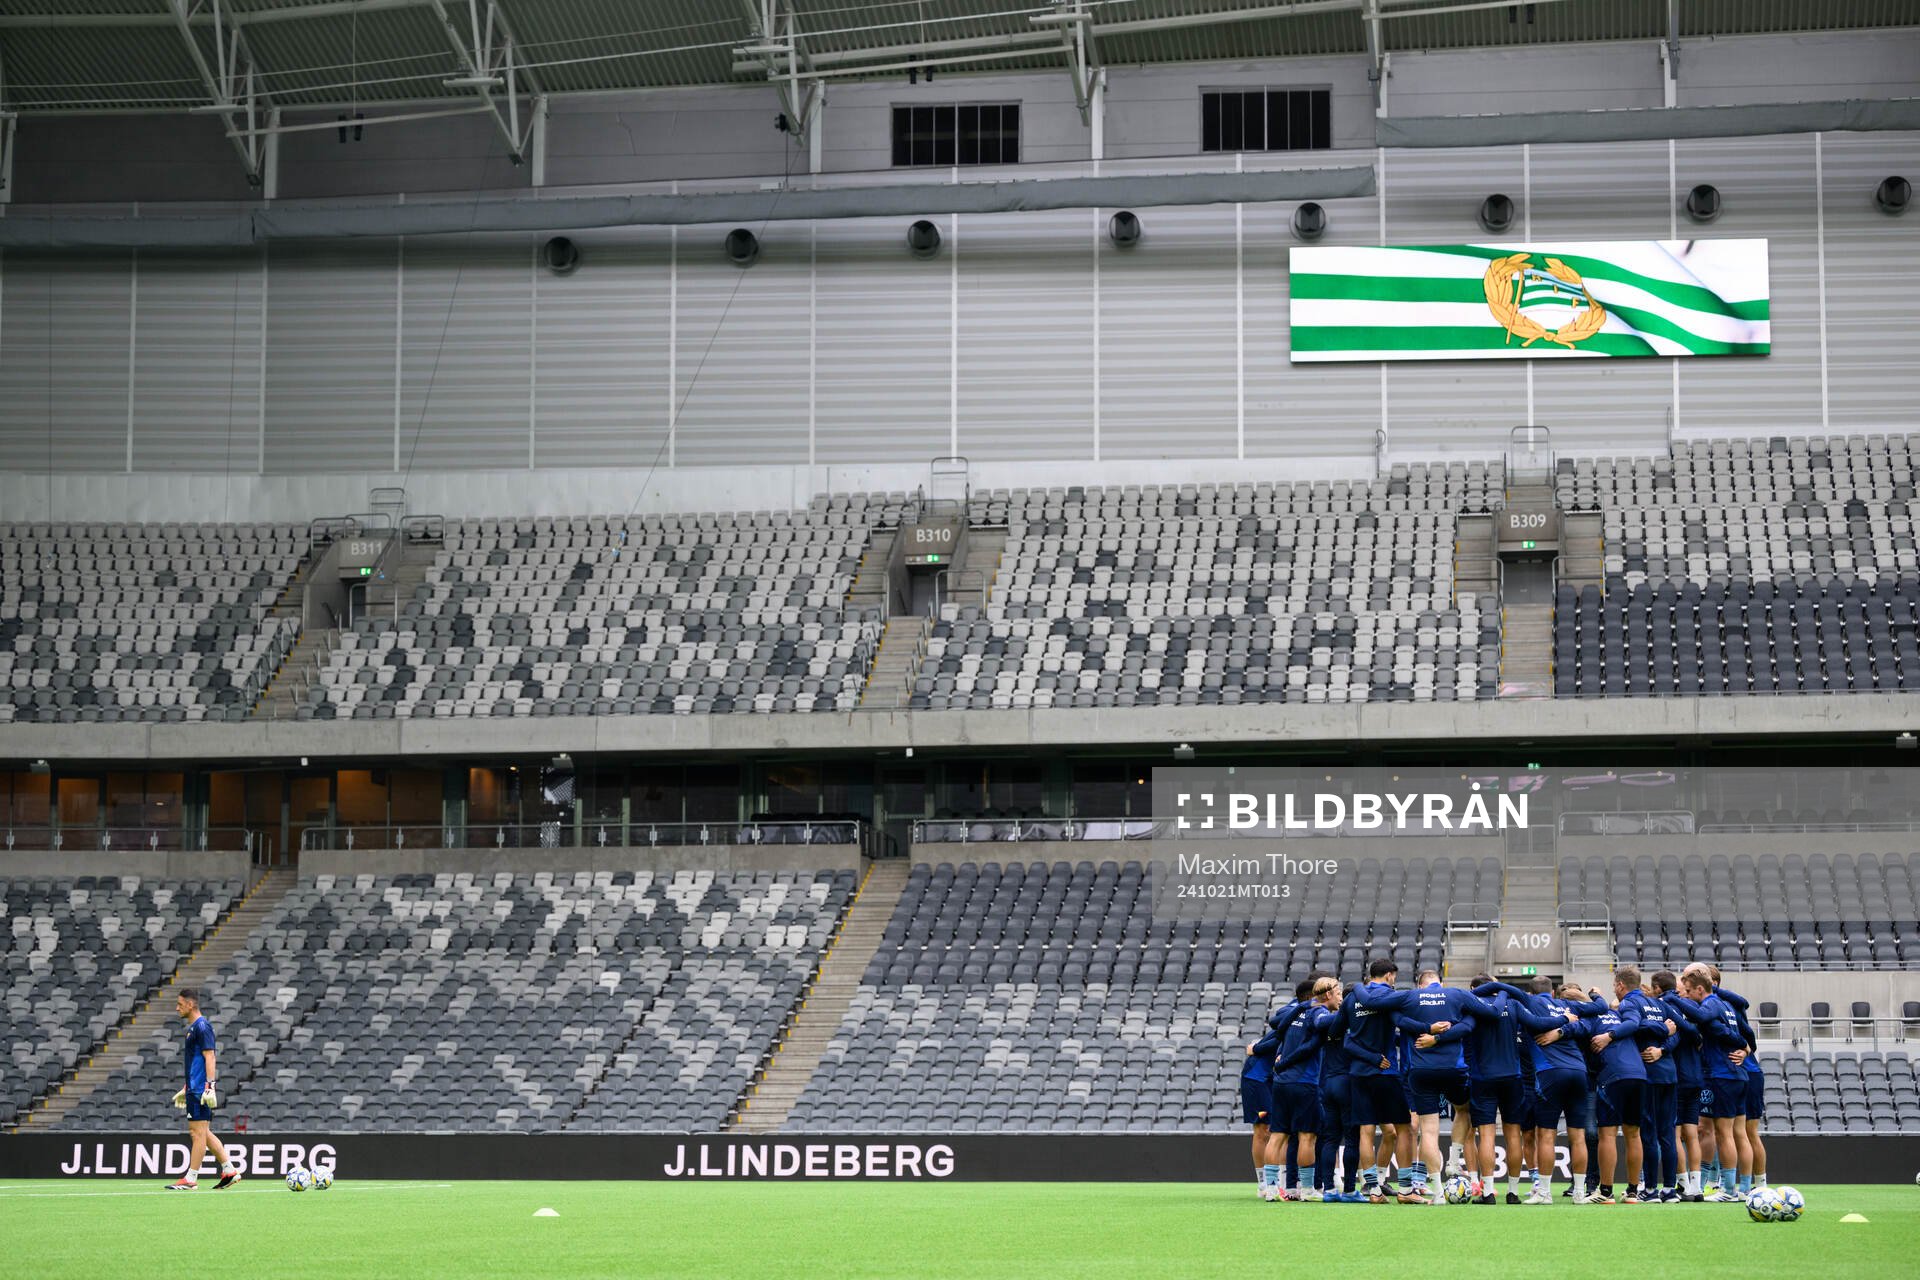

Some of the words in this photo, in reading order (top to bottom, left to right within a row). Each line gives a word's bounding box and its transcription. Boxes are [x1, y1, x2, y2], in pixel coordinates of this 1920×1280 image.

[1510, 514, 1547, 528] B309
[916, 528, 951, 542] B310
[351, 541, 382, 555] B311
[1506, 933, 1551, 949] A109
[663, 1144, 956, 1177] J.LINDEBERG
